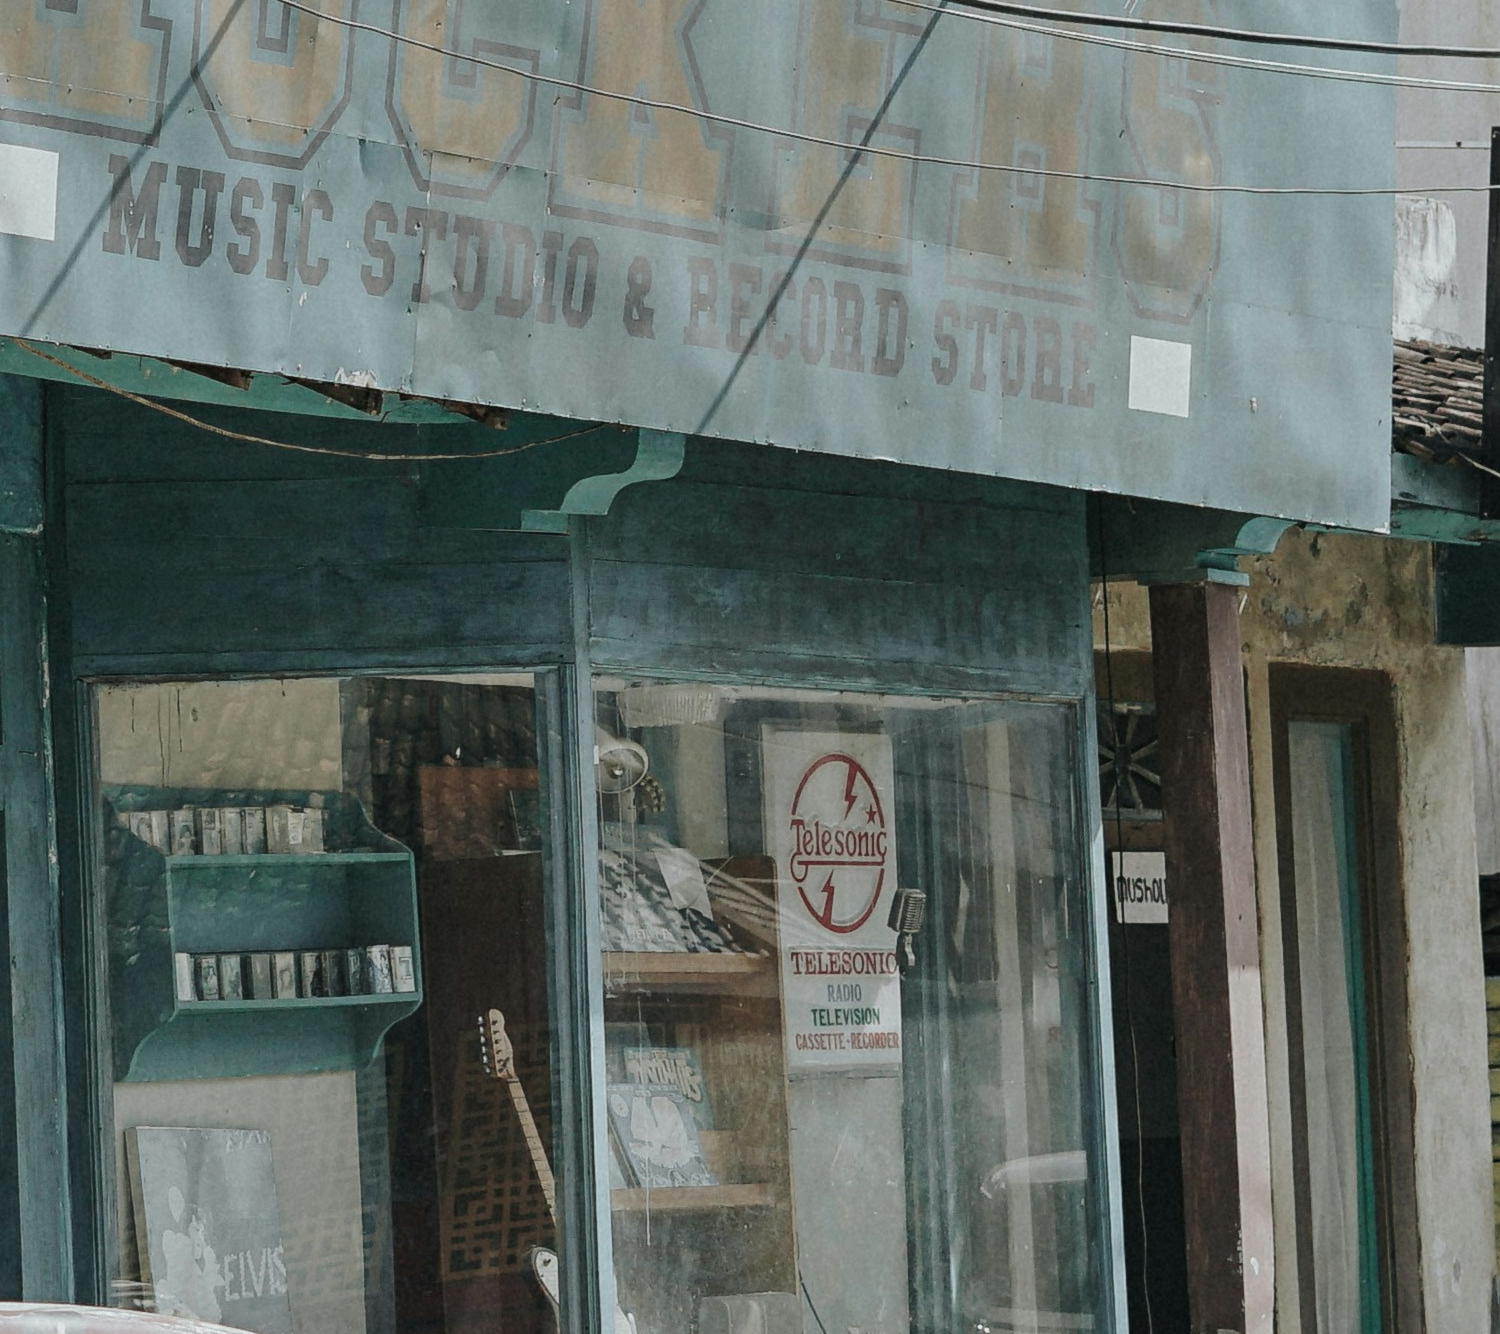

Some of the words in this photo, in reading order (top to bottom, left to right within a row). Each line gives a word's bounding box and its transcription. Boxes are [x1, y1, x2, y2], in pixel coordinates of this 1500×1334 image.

[103, 154, 335, 286] MUSIC
[362, 199, 599, 330] STUDIO
[621, 254, 657, 341] &
[683, 256, 910, 380] RECORD
[930, 297, 1098, 408] STORE
[789, 818, 888, 862] Telesonic
[790, 952, 897, 976] TELESONIC
[827, 984, 863, 1003] RADIO
[811, 1008, 880, 1027] TELEVISION
[223, 1244, 287, 1302] ELVIS
